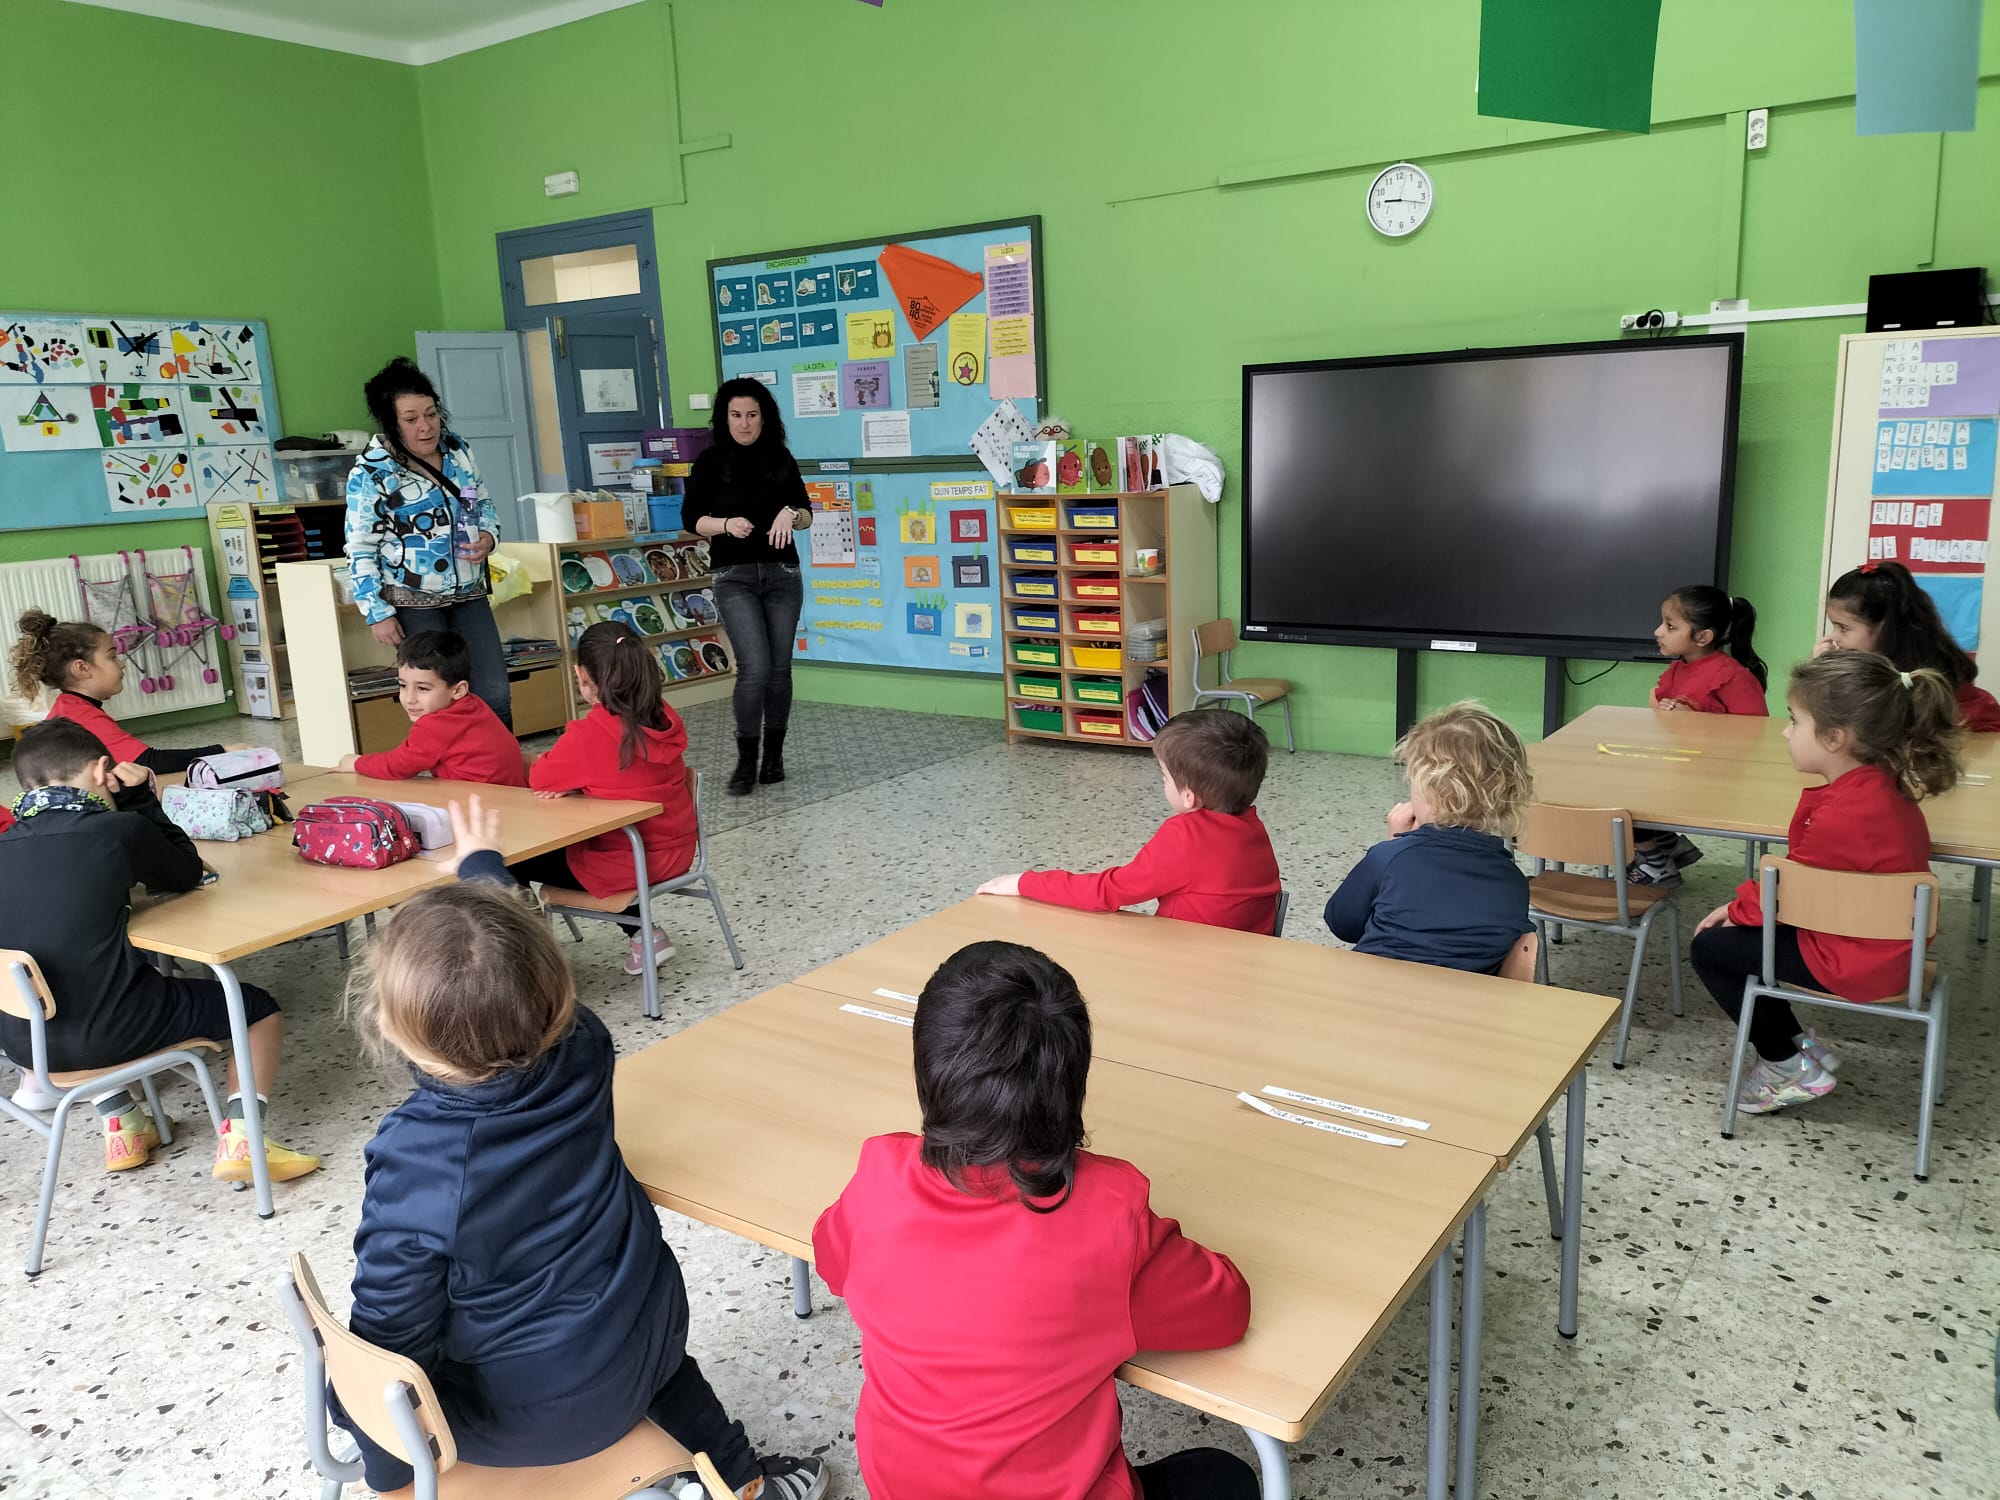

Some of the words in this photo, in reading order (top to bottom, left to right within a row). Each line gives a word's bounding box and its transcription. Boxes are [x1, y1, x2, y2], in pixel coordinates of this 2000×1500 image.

[909, 300, 921, 311] 80
[933, 487, 950, 496] QUIN
[950, 486, 973, 495] TEMPS
[974, 484, 987, 494] FA?
